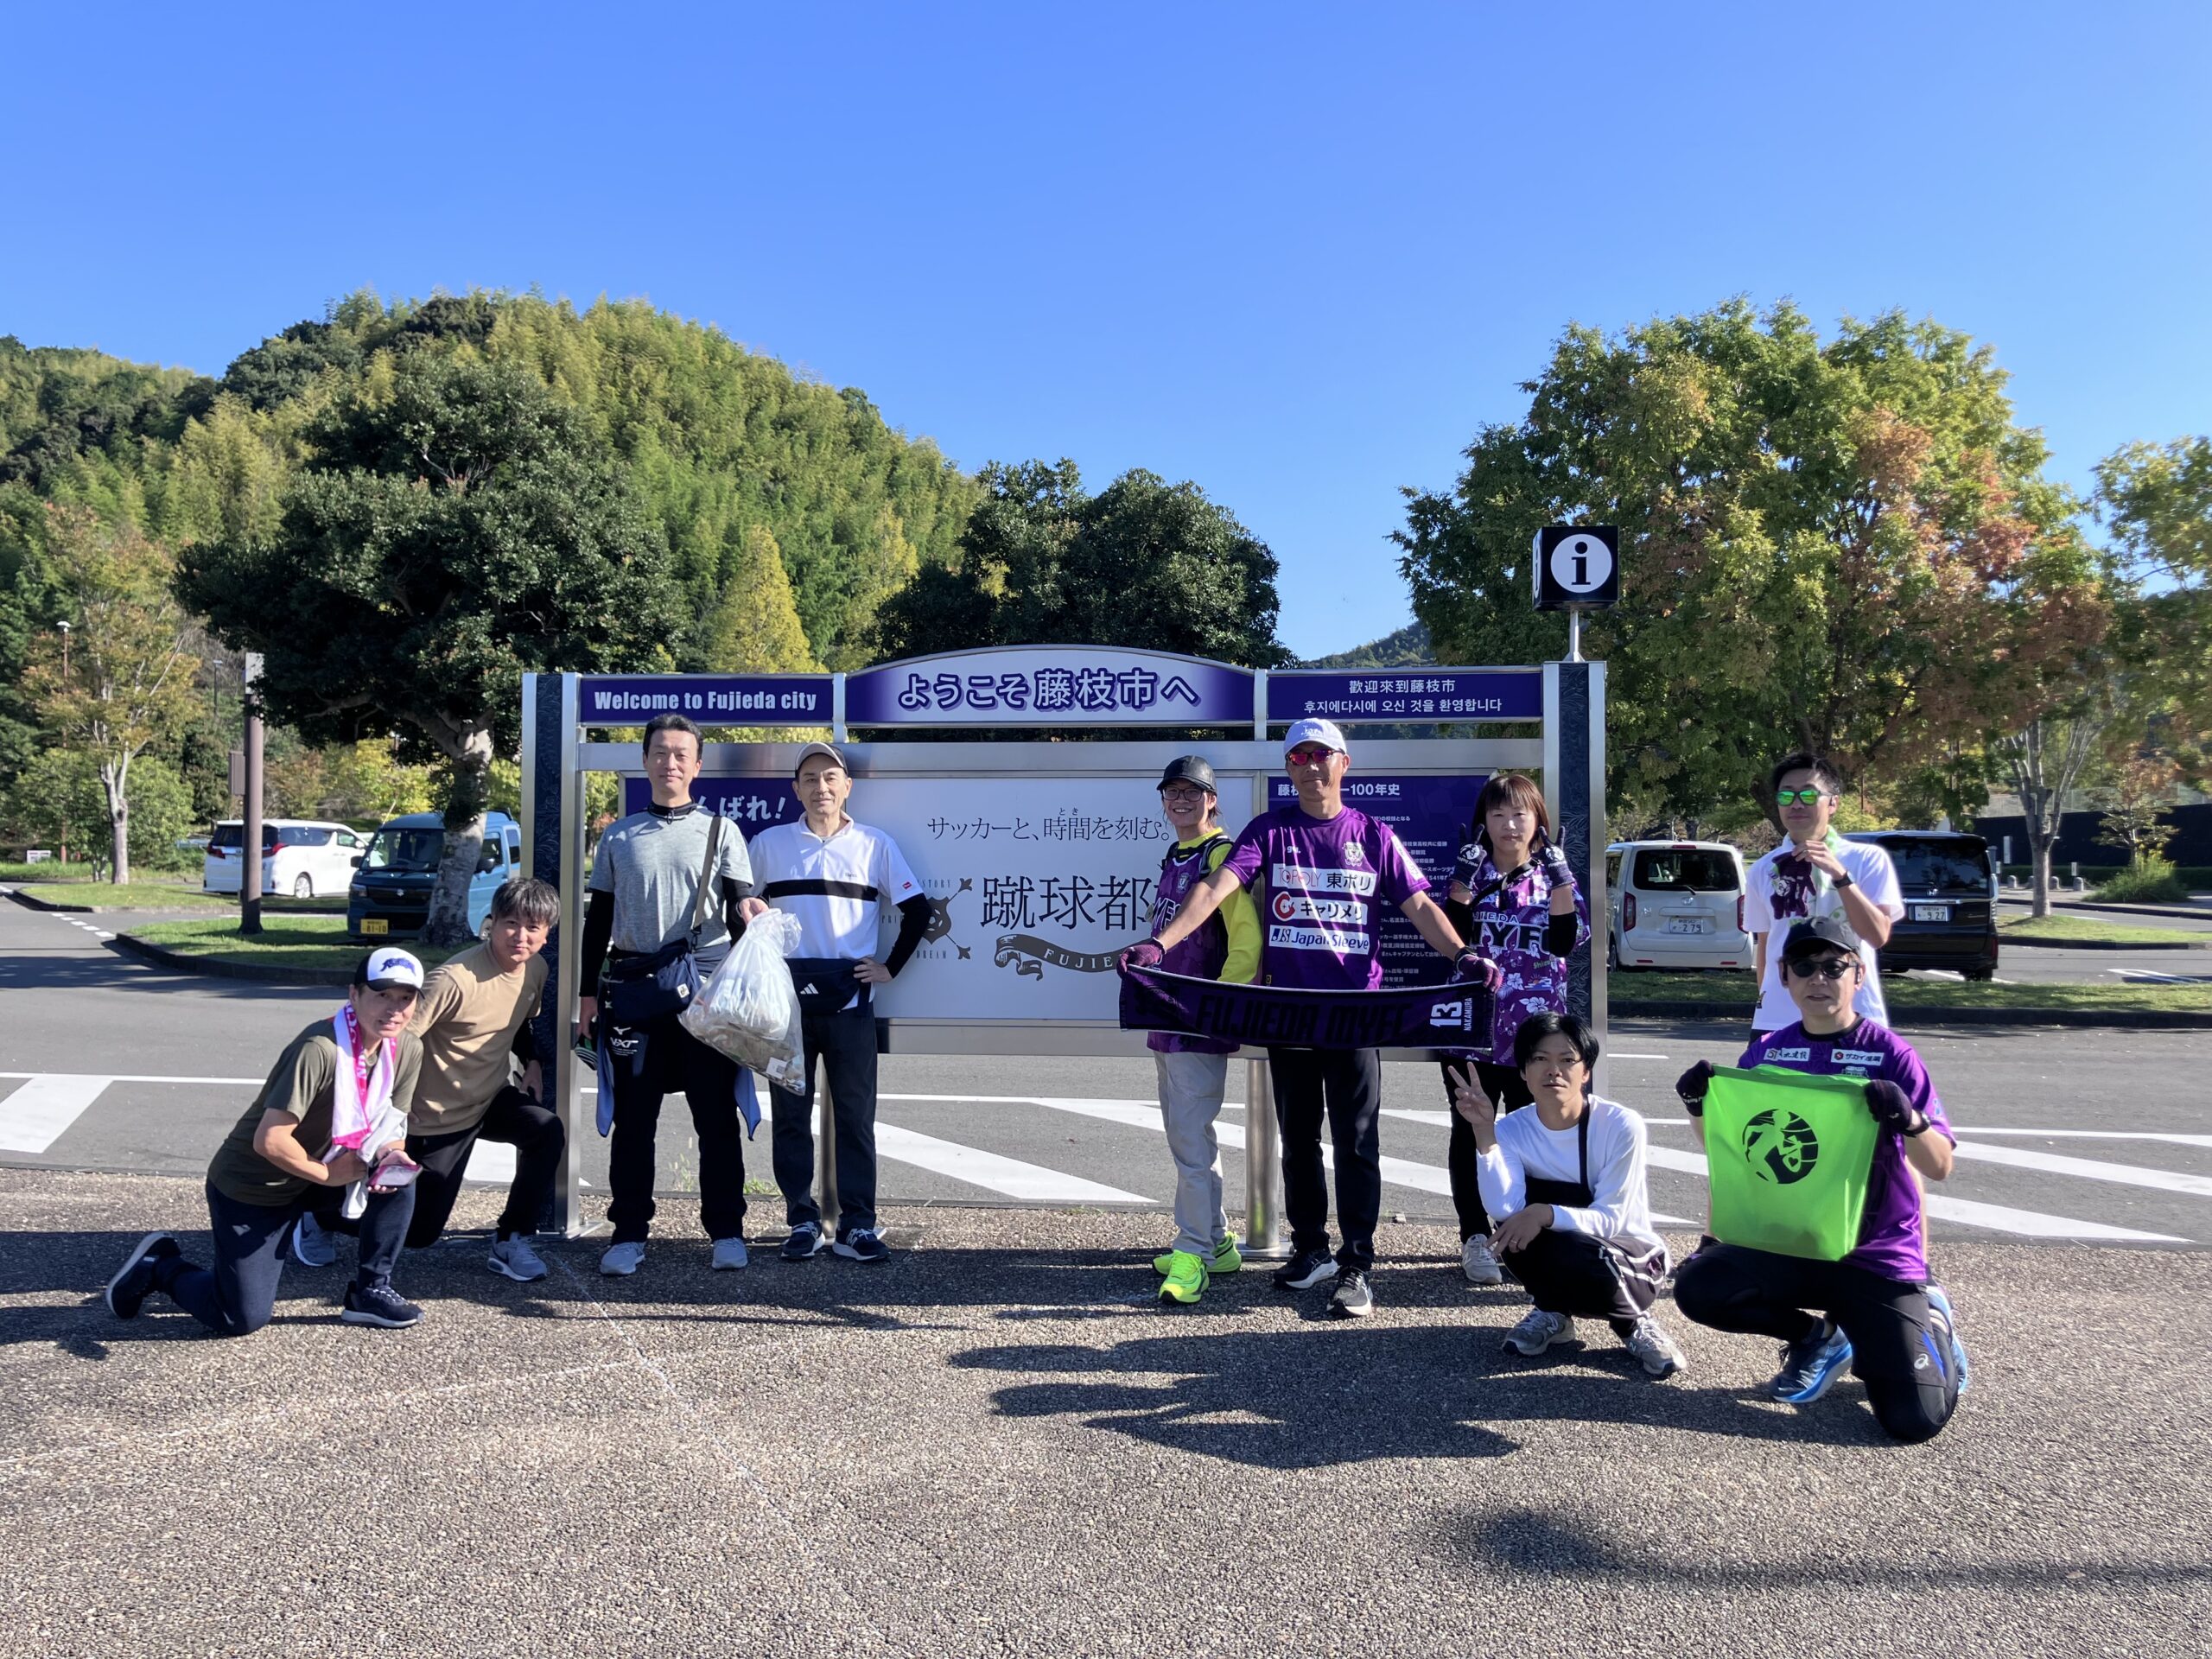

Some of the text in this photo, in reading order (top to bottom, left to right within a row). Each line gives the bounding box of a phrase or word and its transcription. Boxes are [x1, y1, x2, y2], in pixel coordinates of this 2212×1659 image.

[899, 667, 1201, 711] ようこそ藤枝市へ
[1349, 679, 1456, 694] 歡迎來到藤枝市
[594, 691, 817, 711] Welcome to Fujieda city
[1304, 698, 1502, 714] 후지에다시에 오신 것을 환영합니다
[1058, 806, 1079, 817] とき
[927, 817, 1170, 842] サッカーと、時間を刻む。
[1326, 872, 1371, 891] 東ポリ
[1332, 934, 1370, 950] Sleeve
[1430, 1001, 1462, 1027] 13
[1464, 997, 1472, 1031] NAKAMURA
